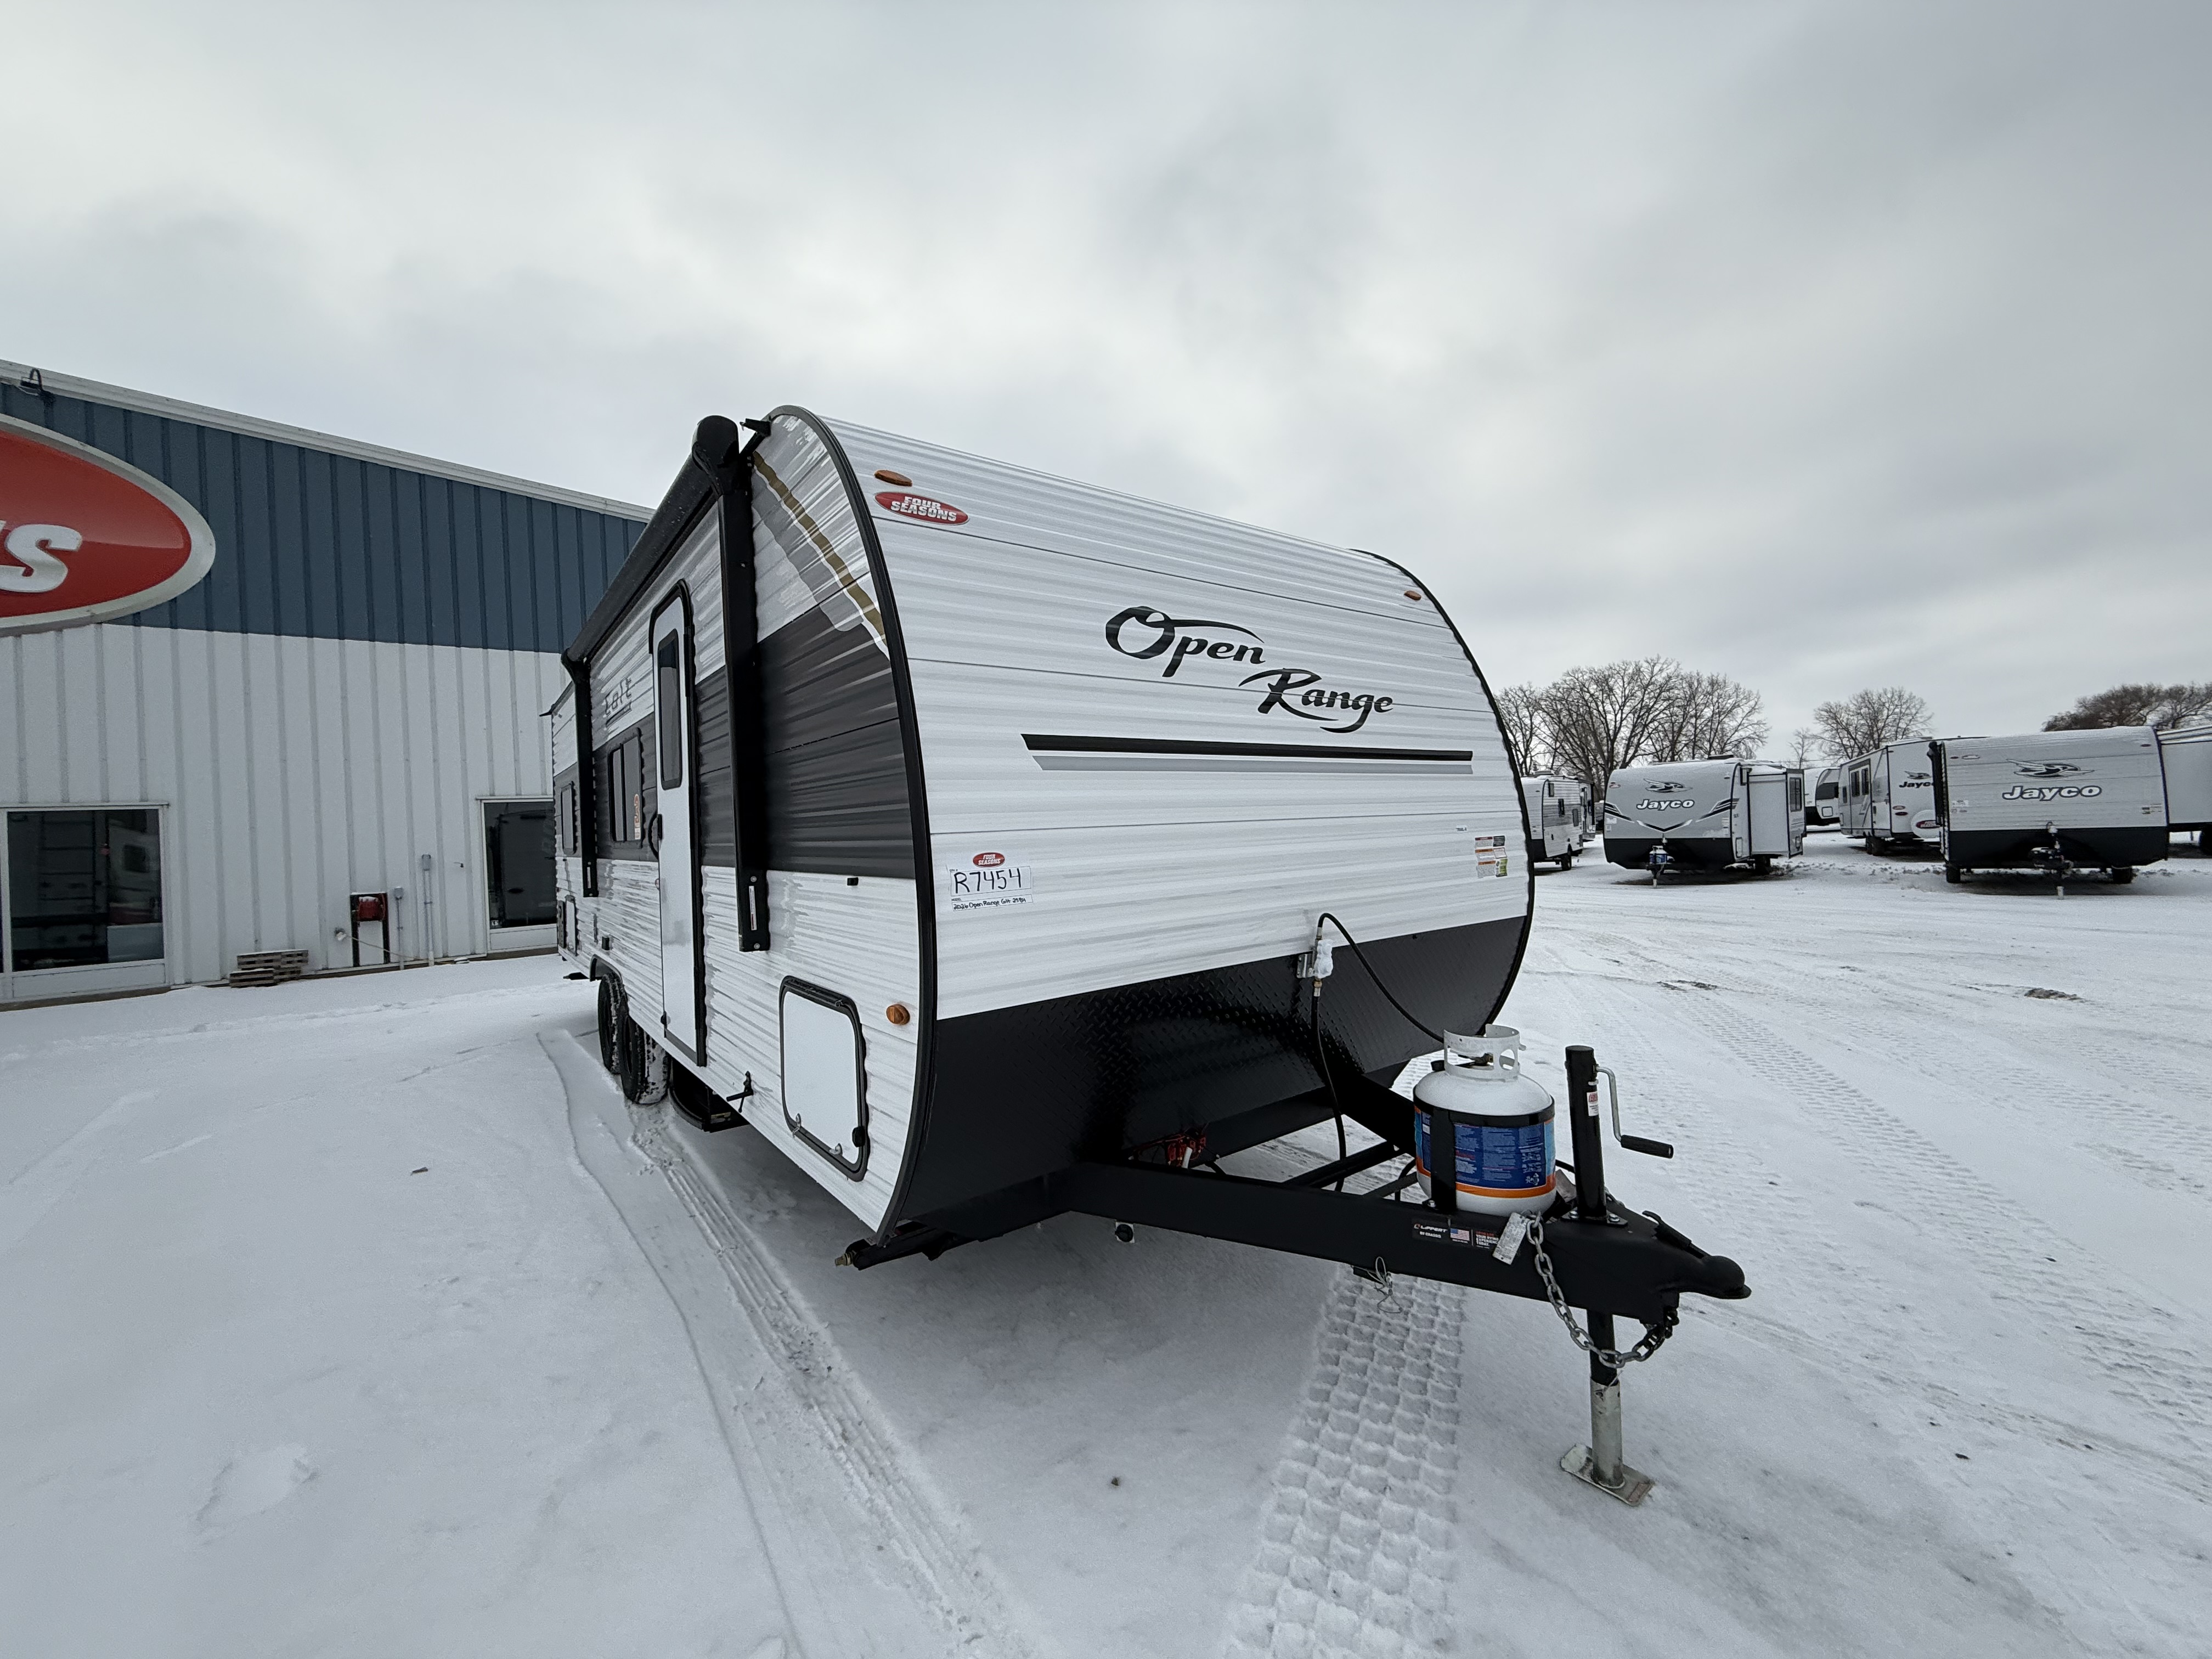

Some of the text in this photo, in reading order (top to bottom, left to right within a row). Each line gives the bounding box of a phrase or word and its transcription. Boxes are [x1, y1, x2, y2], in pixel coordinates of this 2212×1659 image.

[891, 501, 956, 521] SEASONS
[905, 496, 941, 510] FOUR
[0, 521, 82, 592] S
[1105, 606, 1266, 678] Open
[1238, 668, 1393, 733] Range
[2002, 786, 2102, 801] Jayco
[1637, 799, 1695, 811] Jayco
[954, 868, 1021, 893] R7454
